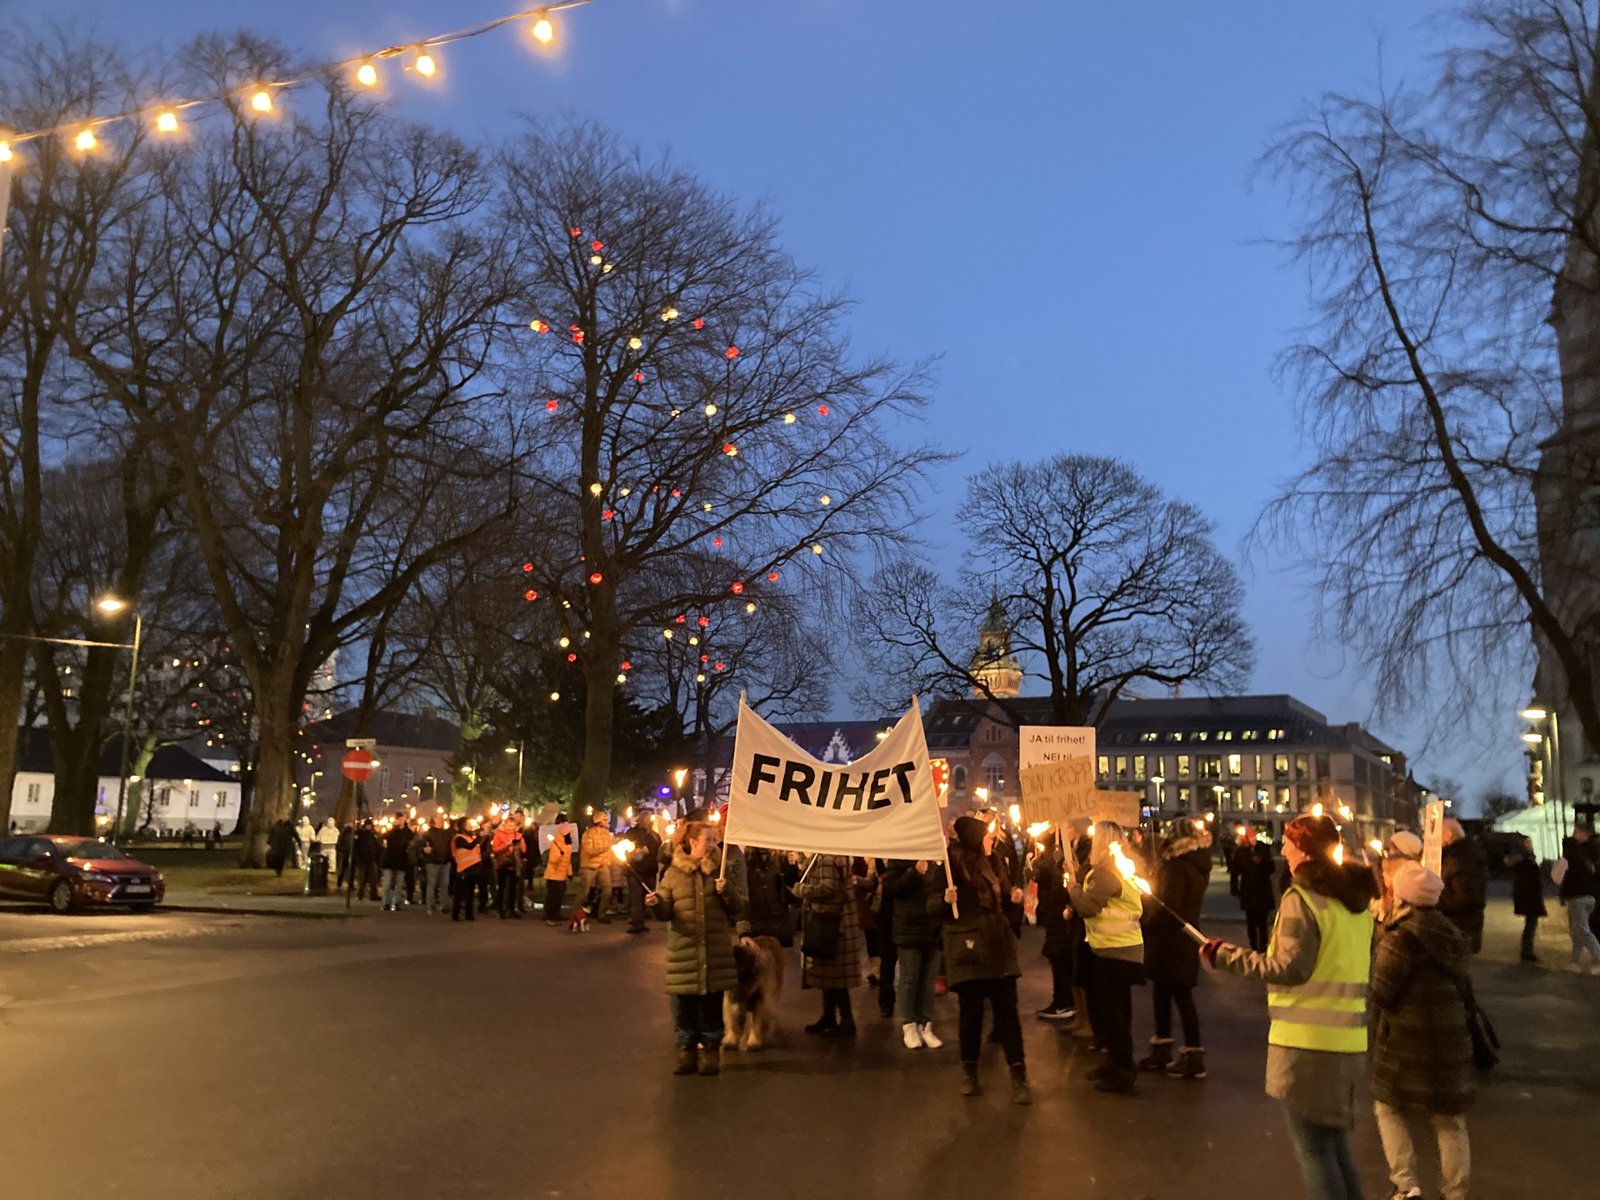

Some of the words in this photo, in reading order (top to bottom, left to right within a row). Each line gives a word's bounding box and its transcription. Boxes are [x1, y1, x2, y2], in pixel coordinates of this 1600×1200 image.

[1029, 734, 1043, 744] JA
[1044, 734, 1054, 744] til
[1056, 735, 1085, 744] frihet!
[1043, 752, 1061, 761] NEI
[747, 753, 916, 811] FRIHET
[1022, 774, 1044, 797] DIN
[1050, 761, 1092, 790] KROPP
[1058, 788, 1097, 816] VALG
